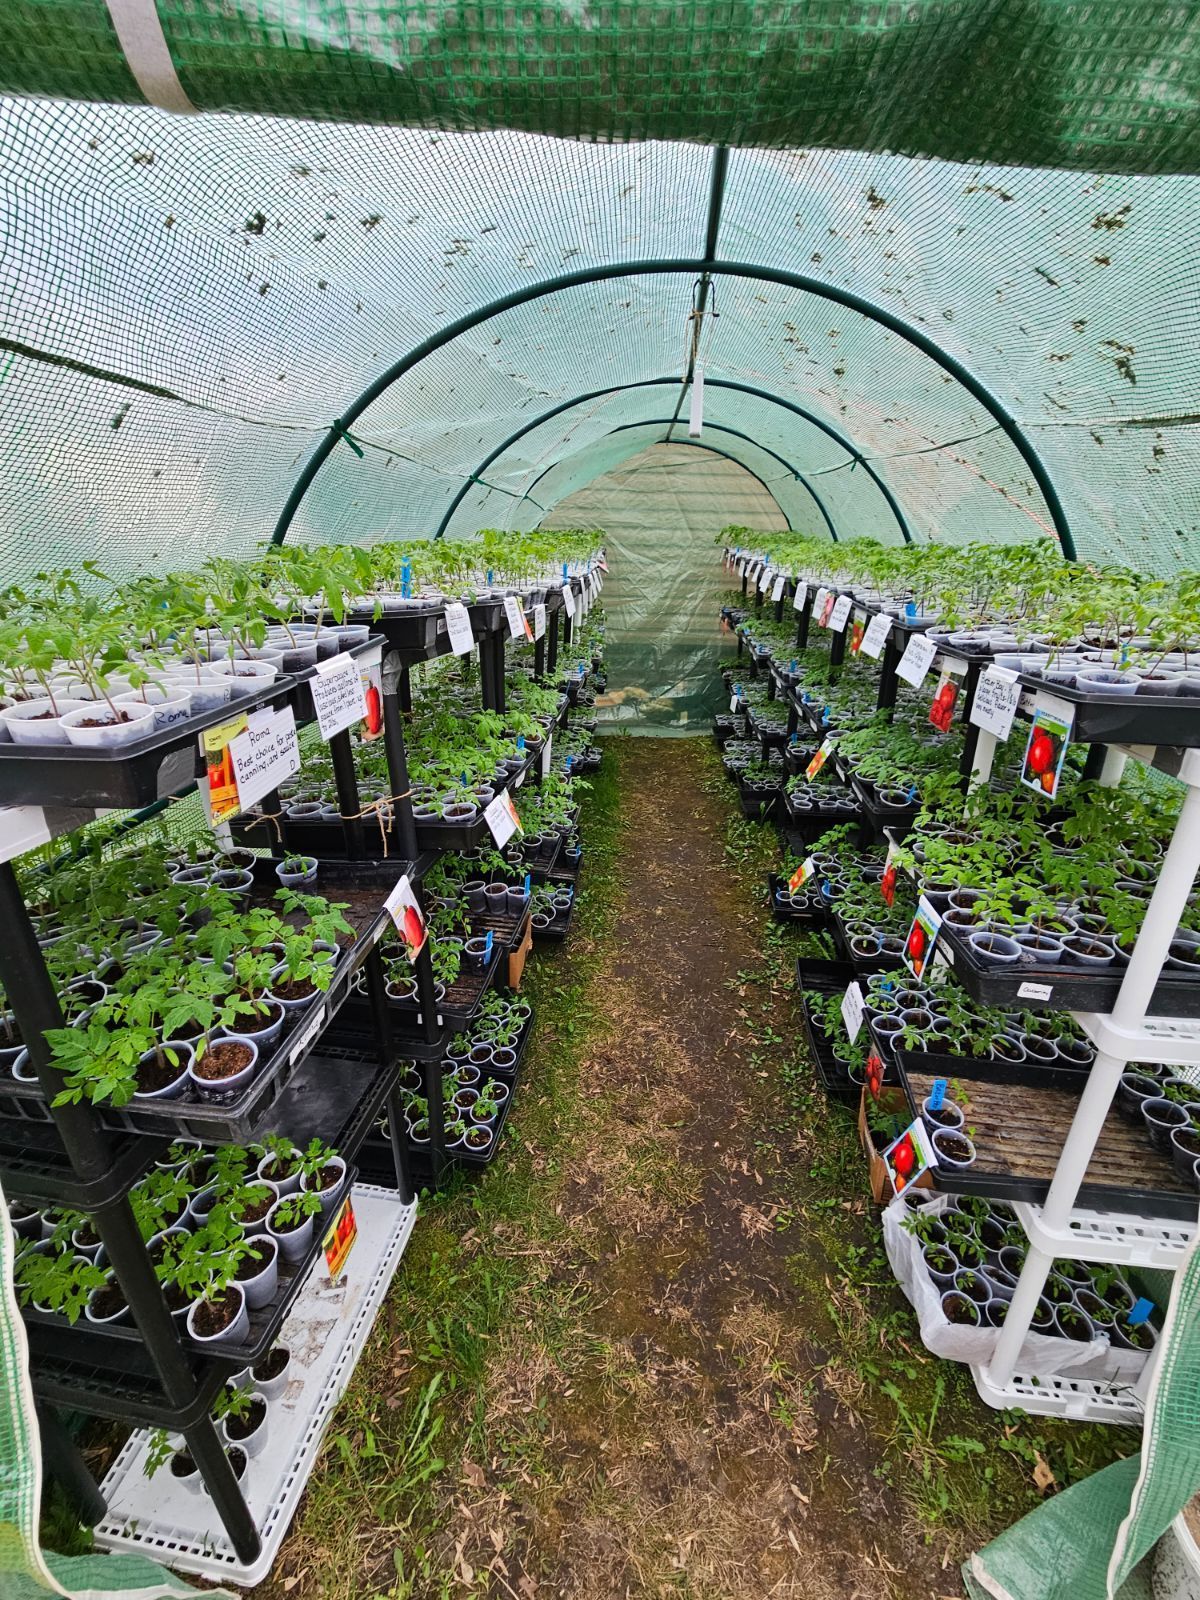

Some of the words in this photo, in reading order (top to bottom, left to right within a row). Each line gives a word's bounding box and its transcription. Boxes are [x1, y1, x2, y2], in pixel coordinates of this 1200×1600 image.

[154, 709, 190, 725] Roma
[248, 727, 270, 747] Roma
[237, 756, 253, 771] Best
[255, 744, 275, 760] choice
